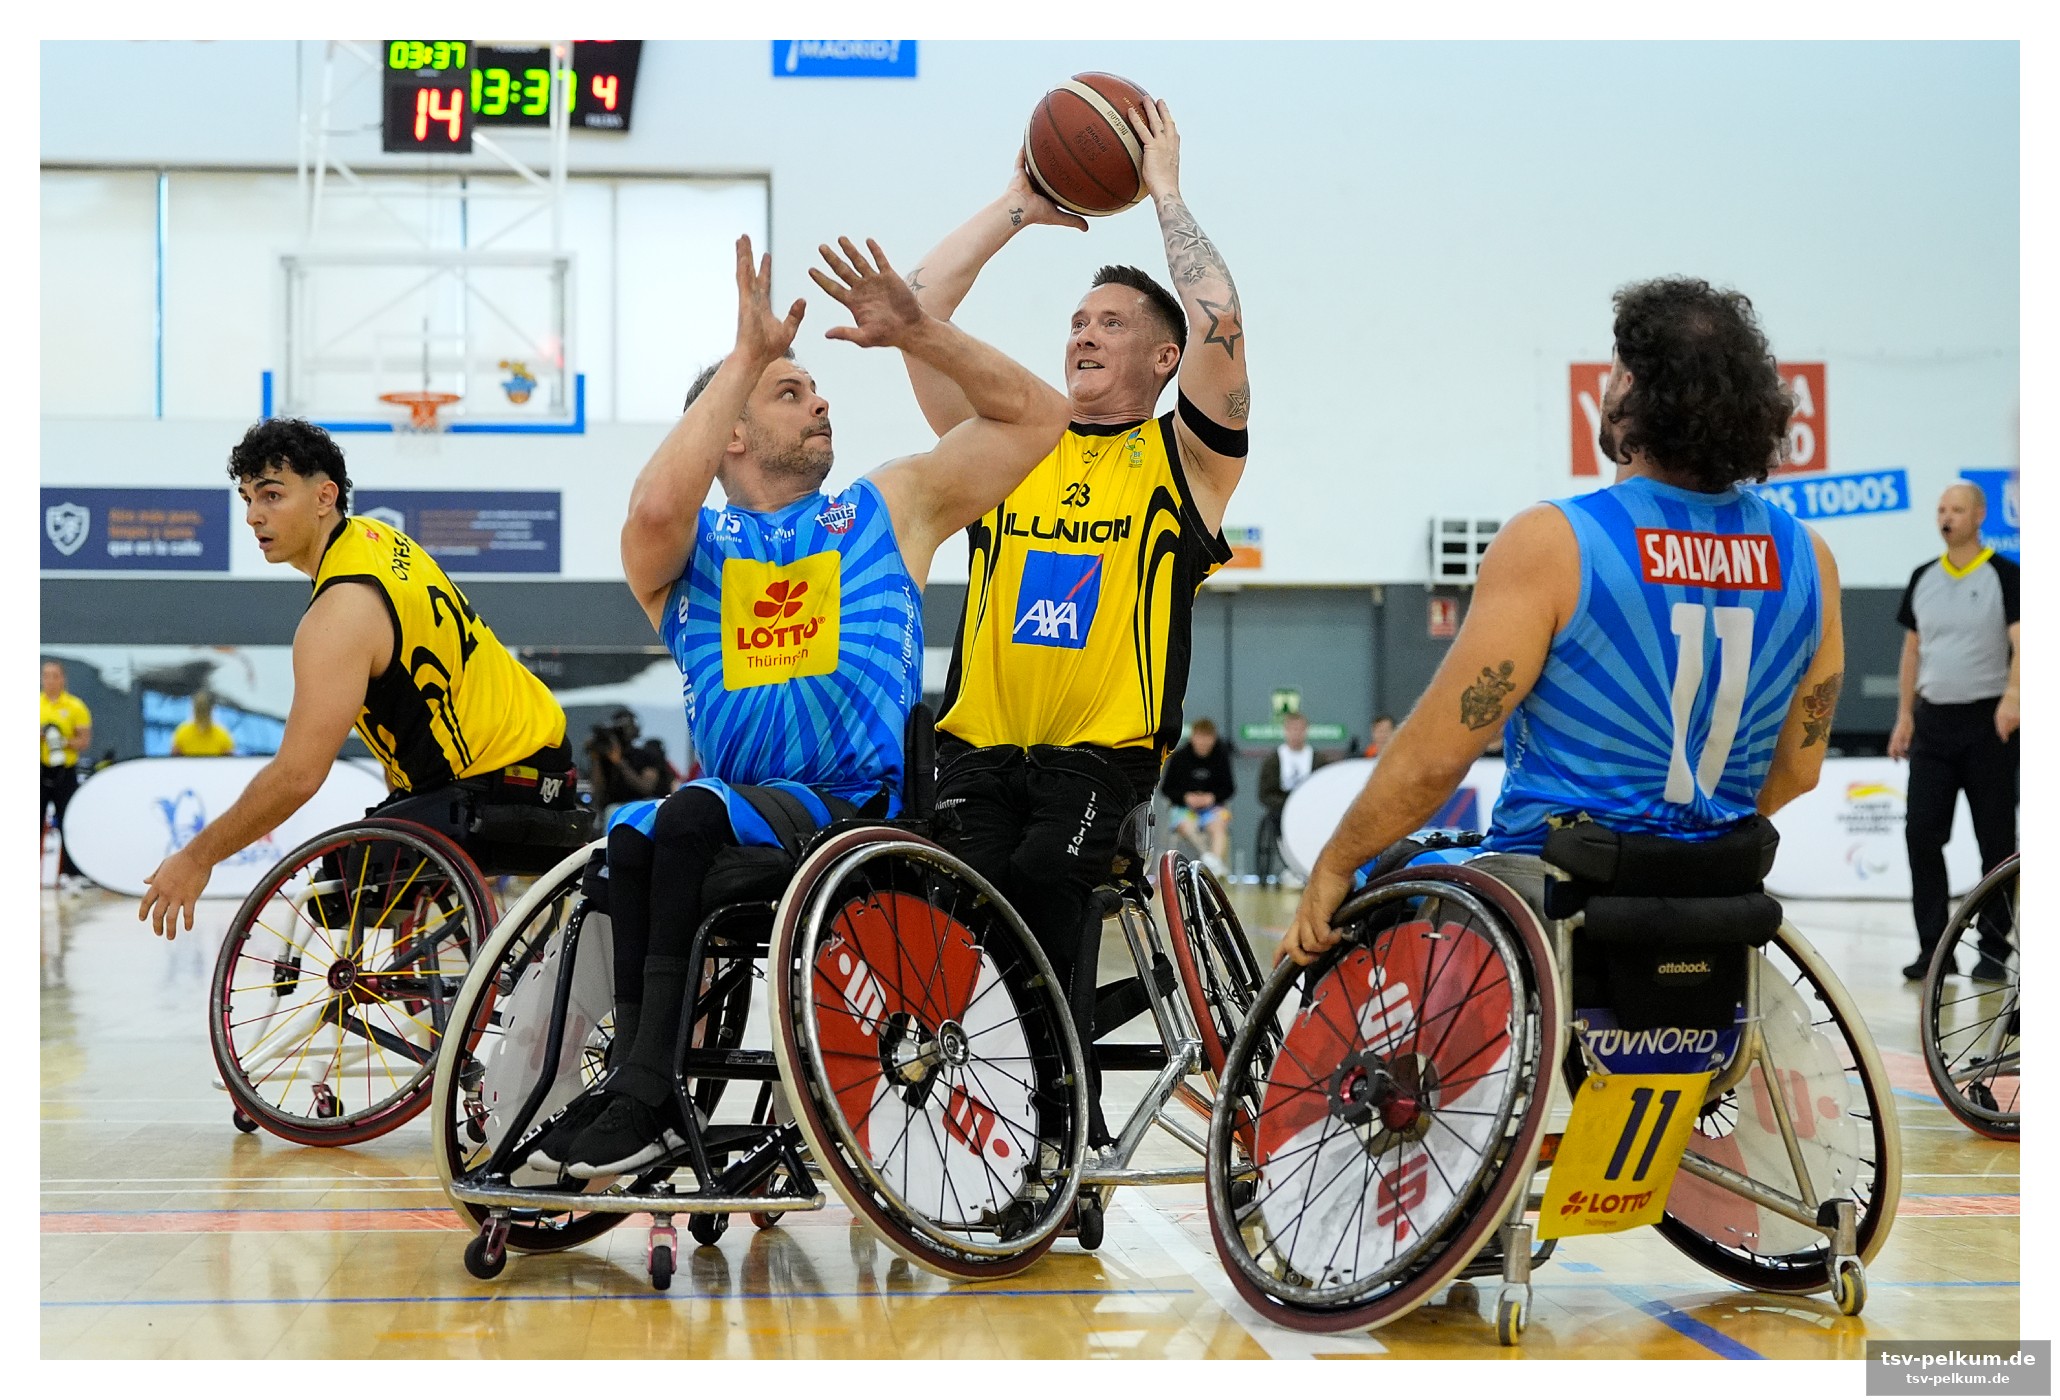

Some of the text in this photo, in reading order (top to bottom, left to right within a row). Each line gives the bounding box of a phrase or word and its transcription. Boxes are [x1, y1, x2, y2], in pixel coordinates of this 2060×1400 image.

[389, 41, 467, 70] 03:37
[591, 74, 618, 111] 4
[414, 87, 464, 142] 14
[1061, 482, 1091, 508] 23
[1803, 473, 1900, 516] TODOS
[1003, 512, 1132, 543] ILUNION
[1645, 533, 1769, 585] SALVANY
[1013, 599, 1079, 641] AXA
[1664, 602, 1755, 805] 11
[1604, 1087, 1682, 1181] 11
